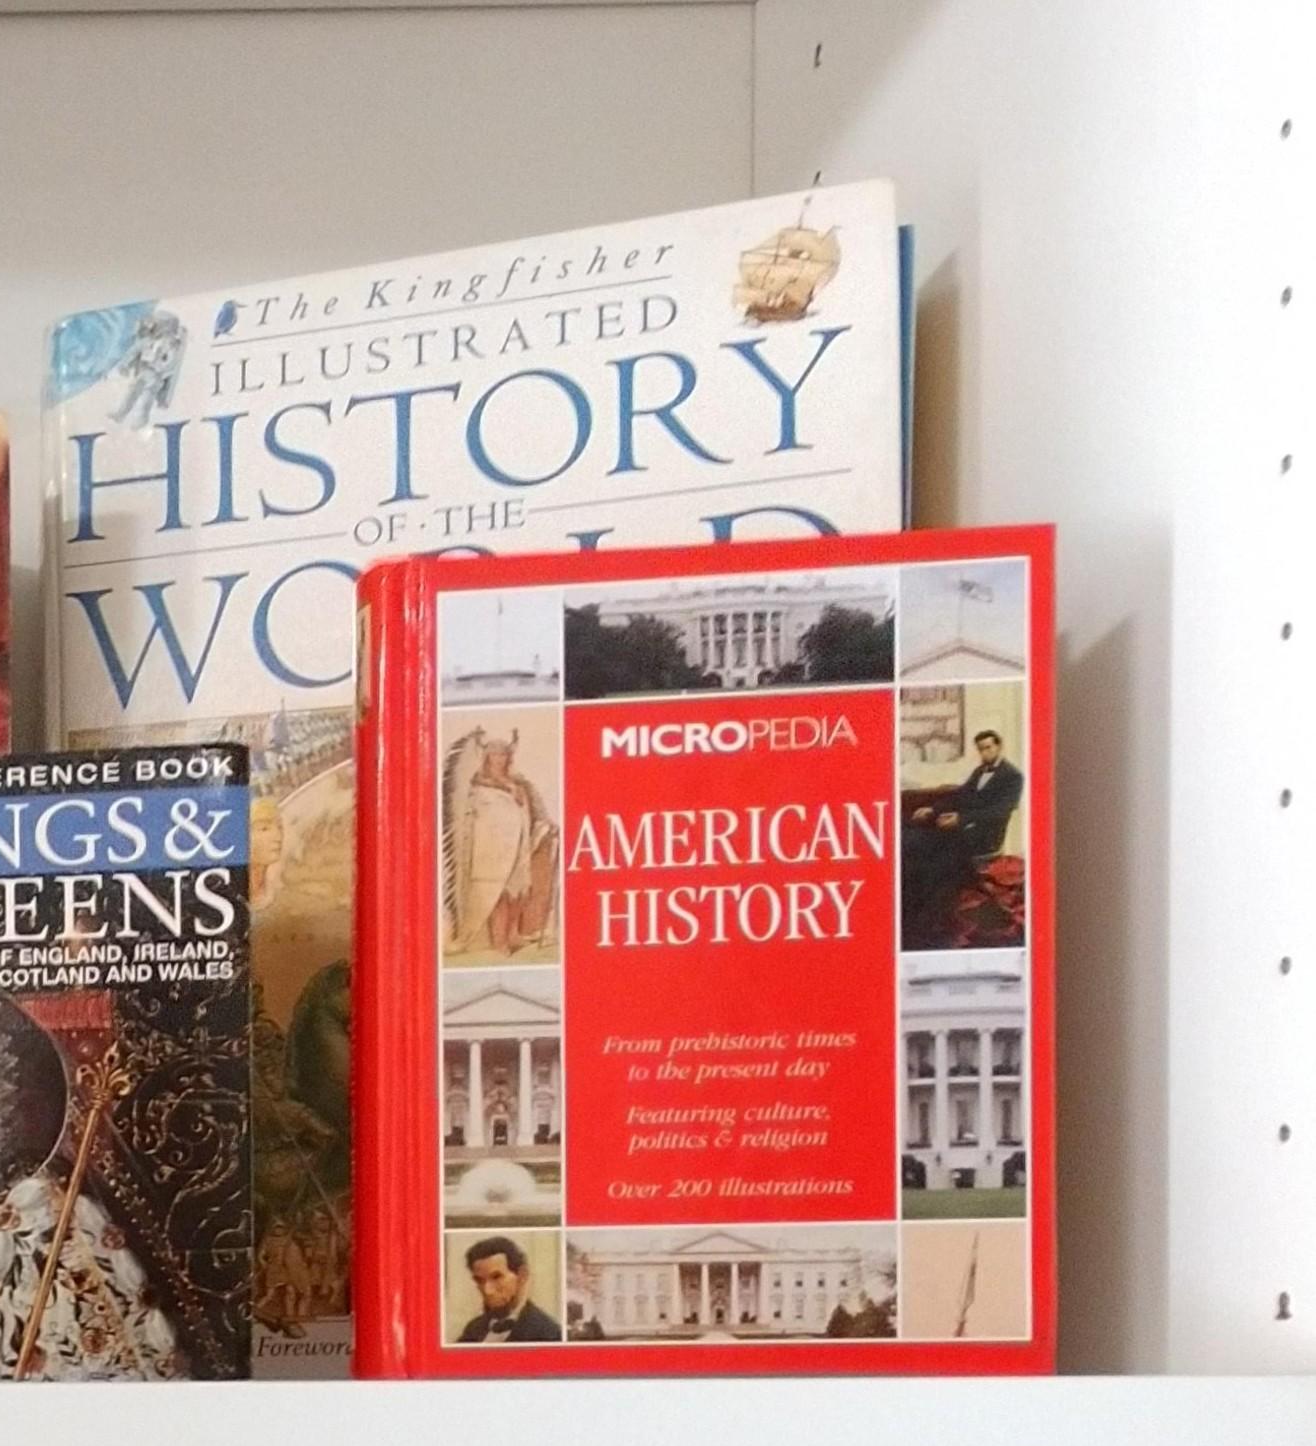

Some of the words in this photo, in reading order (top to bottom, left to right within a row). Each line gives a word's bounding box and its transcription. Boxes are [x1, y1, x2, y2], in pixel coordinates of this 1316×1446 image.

[254, 291, 350, 328] The
[366, 239, 677, 311] Kingfisher
[210, 293, 679, 396] ILLUSTRATED
[68, 324, 853, 545] HISTORY
[353, 511, 409, 548] OF
[433, 498, 526, 534] THE
[601, 714, 858, 759] MICROPEDIA
[136, 756, 234, 781] BOOK
[164, 798, 236, 861] &
[568, 801, 889, 874] AMERICAN
[596, 880, 864, 949] HISTORY
[19, 942, 129, 966] ENGLAND,
[133, 940, 236, 963] IRELAND,
[105, 963, 152, 984] AND
[157, 960, 235, 982] WALES
[603, 1035, 662, 1056] From
[669, 1028, 789, 1060] prehistoric
[797, 1028, 857, 1049] times
[627, 1063, 650, 1082] to
[656, 1059, 691, 1082] the
[696, 1060, 779, 1086] present
[785, 1057, 829, 1083] day
[607, 1179, 660, 1200] Over
[667, 1178, 713, 1199] 200
[719, 1173, 855, 1198] illustrations
